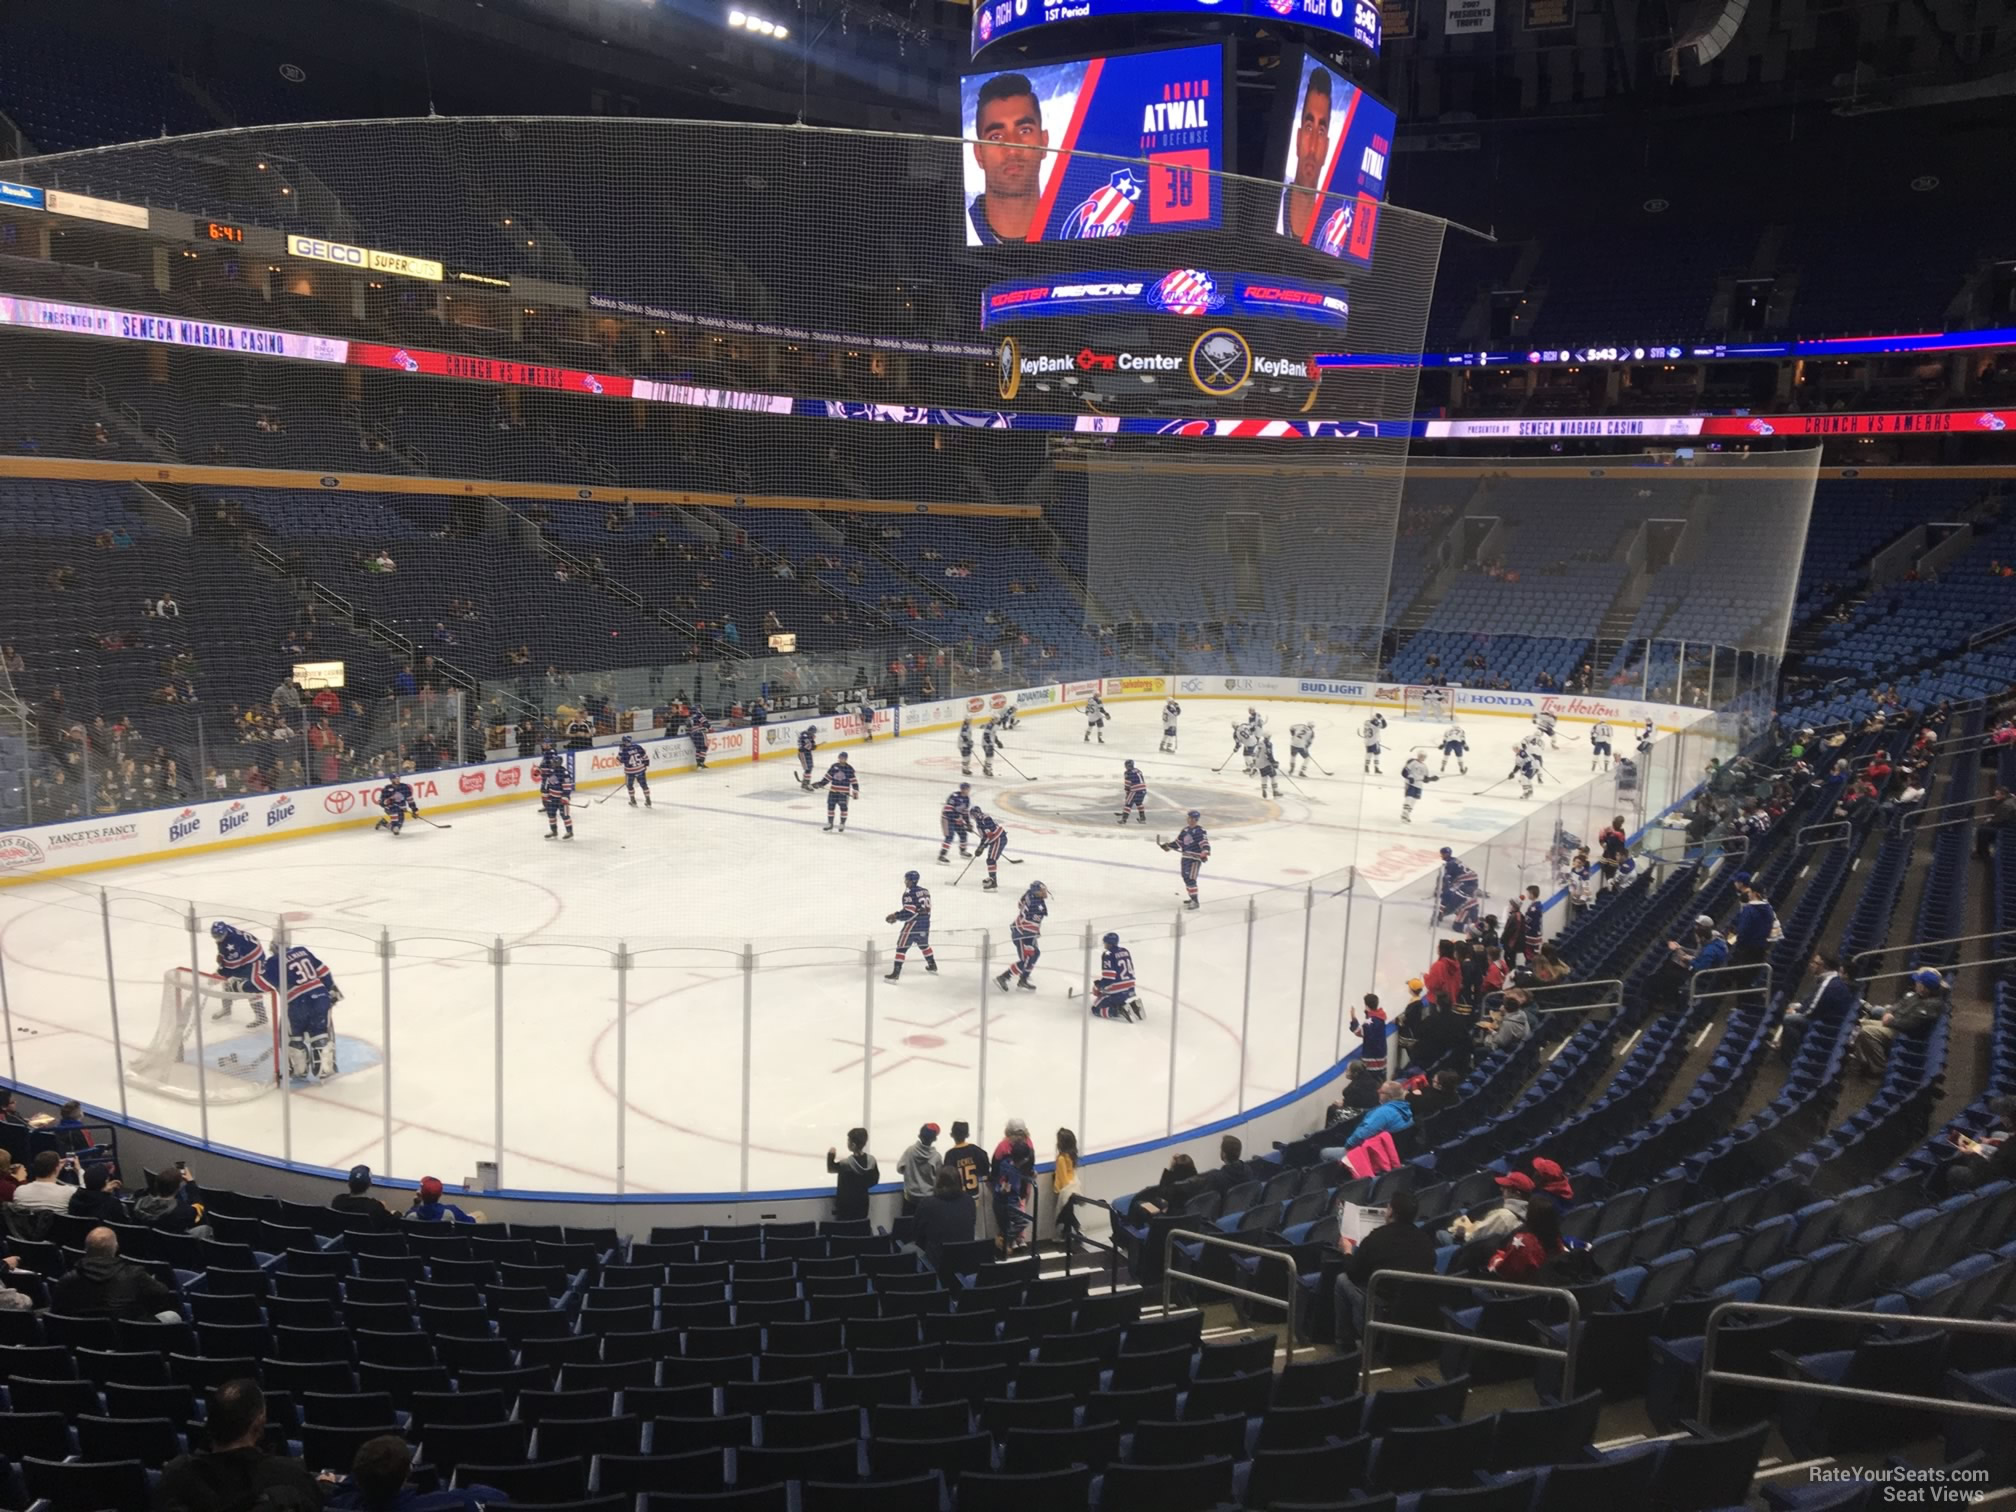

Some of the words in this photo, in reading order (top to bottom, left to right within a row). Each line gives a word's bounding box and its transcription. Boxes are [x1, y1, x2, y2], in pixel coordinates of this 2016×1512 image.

[1045, 10, 1059, 21] 1ST
[1061, 3, 1090, 18] Period
[1354, 3, 1377, 34] 5:43
[1450, 9, 1491, 20] PRESIDENTS
[1456, 18, 1483, 28] TROPHY
[1143, 99, 1208, 133] ATWAL
[1163, 130, 1209, 147] DEFENSE
[208, 223, 243, 242] 6:41
[296, 239, 361, 264] GEICO
[374, 254, 436, 276] SUPERCUTS
[1244, 286, 1323, 304] ROCHESTER
[42, 310, 93, 329] PRESENTED
[97, 317, 107, 329] BY
[122, 316, 174, 342] SENECA
[180, 327, 235, 350] NIAGARA
[241, 332, 284, 355] CASINO
[1020, 354, 1074, 374] KeyBank
[1118, 353, 1183, 370] Center
[1587, 348, 1617, 361] 5:43
[447, 355, 492, 378] CRUNCH
[500, 362, 513, 382] VS
[1254, 356, 1307, 378] KeyBank
[1093, 417, 1104, 431] VS
[1468, 425, 1500, 434] PRESENTED
[1519, 422, 1555, 436] SENECA
[1560, 421, 1601, 435] NIAGARA
[1607, 420, 1643, 434] CASINO
[1805, 416, 1857, 433] CRUNCH
[1868, 415, 1883, 432] VS
[1894, 414, 1951, 431] AMERKS
[1236, 678, 1253, 690] UR
[1301, 682, 1326, 693] BUD
[1328, 682, 1364, 696] LIGHT
[1016, 689, 1050, 704] ADVANTAGE
[1471, 695, 1536, 707] HONDA
[1540, 696, 1566, 713] Tim
[1567, 697, 1621, 718] Hortons
[776, 727, 791, 740] UR
[629, 754, 642, 767] 45
[359, 781, 439, 807] TOTA
[219, 809, 249, 835] Blue
[266, 803, 295, 827] Blue
[48, 829, 100, 845] YANCEY'S
[102, 824, 137, 837] FANCY
[169, 817, 201, 842] Blue
[289, 958, 317, 984] 30
[1118, 958, 1135, 980] 24
[958, 1164, 976, 1191] 15
